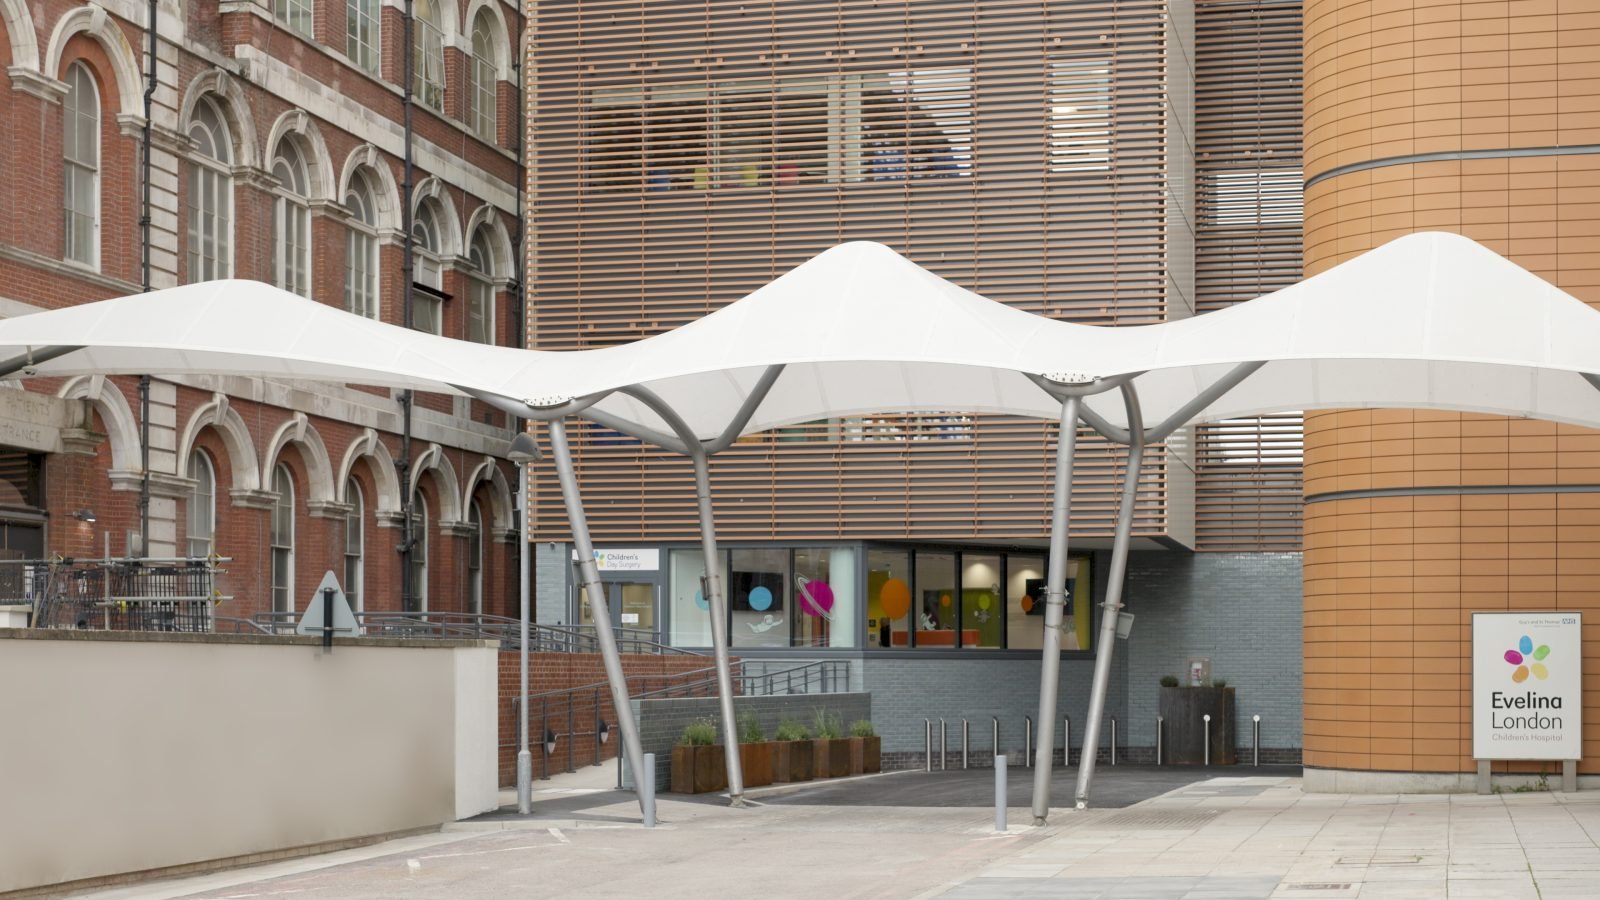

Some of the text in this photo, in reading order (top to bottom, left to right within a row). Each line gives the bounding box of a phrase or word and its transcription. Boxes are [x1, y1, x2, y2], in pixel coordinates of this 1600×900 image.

[607, 553, 639, 561] Children's
[607, 561, 641, 569] Day Surgery
[1492, 691, 1562, 709] Evelina
[1492, 711, 1562, 729] London
[1531, 734, 1563, 742] Hospital
